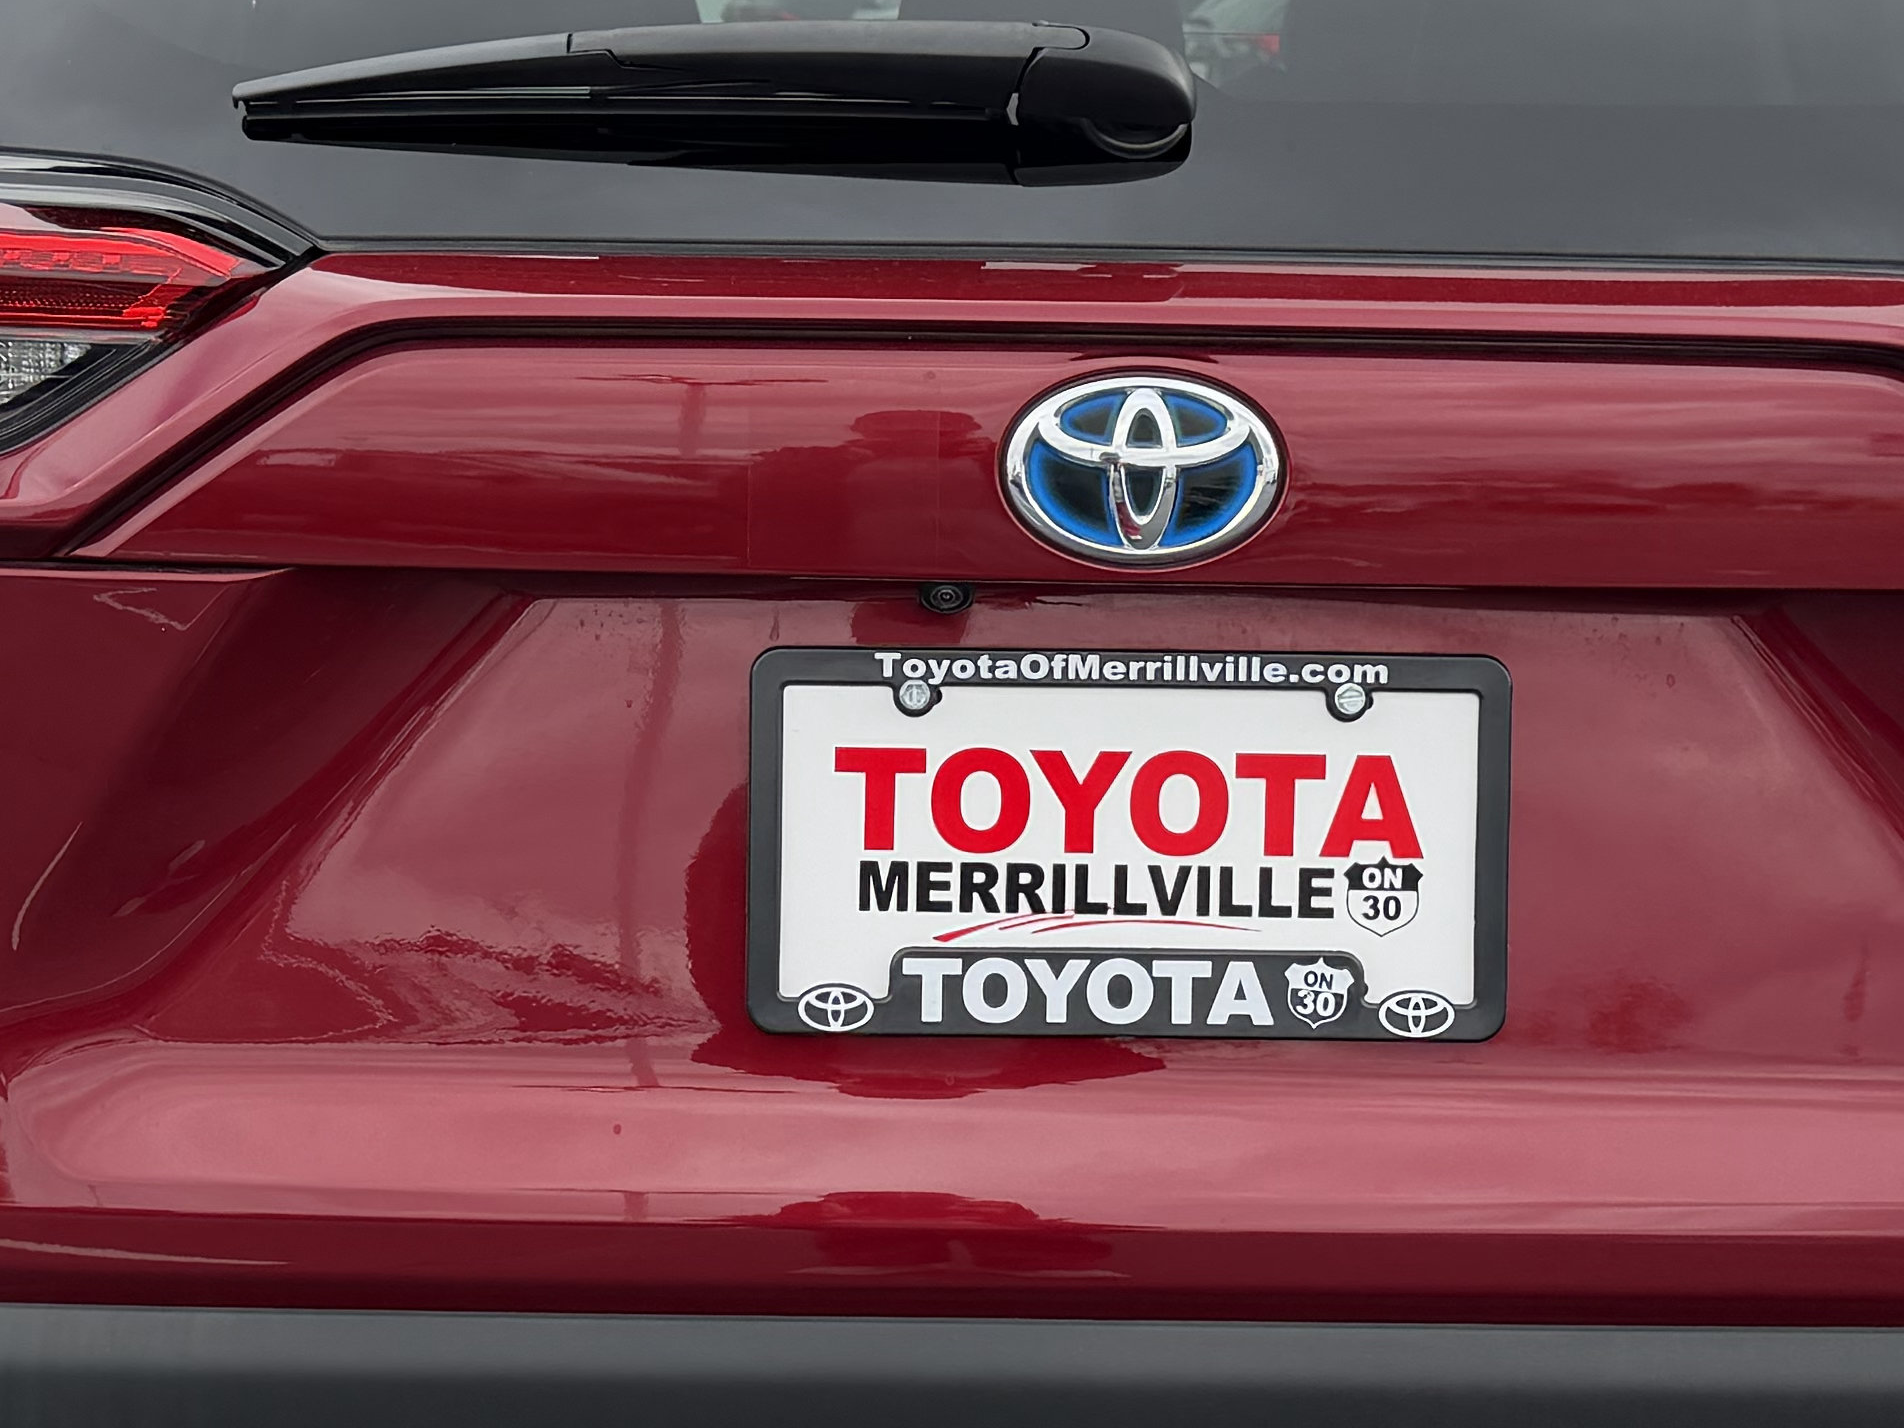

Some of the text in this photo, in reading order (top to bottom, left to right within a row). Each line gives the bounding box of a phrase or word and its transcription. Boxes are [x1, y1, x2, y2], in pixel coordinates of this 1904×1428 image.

[874, 652, 1389, 686] ToyotaOfMerrillville.com
[834, 746, 1424, 859] TOYOTA
[858, 860, 1335, 919] MERRILLVILLE
[1362, 867, 1403, 889] ON
[1361, 895, 1402, 921] 30
[902, 957, 1274, 1026] TOYOTA
[1303, 970, 1334, 990] ON
[1296, 989, 1336, 1017] 30
